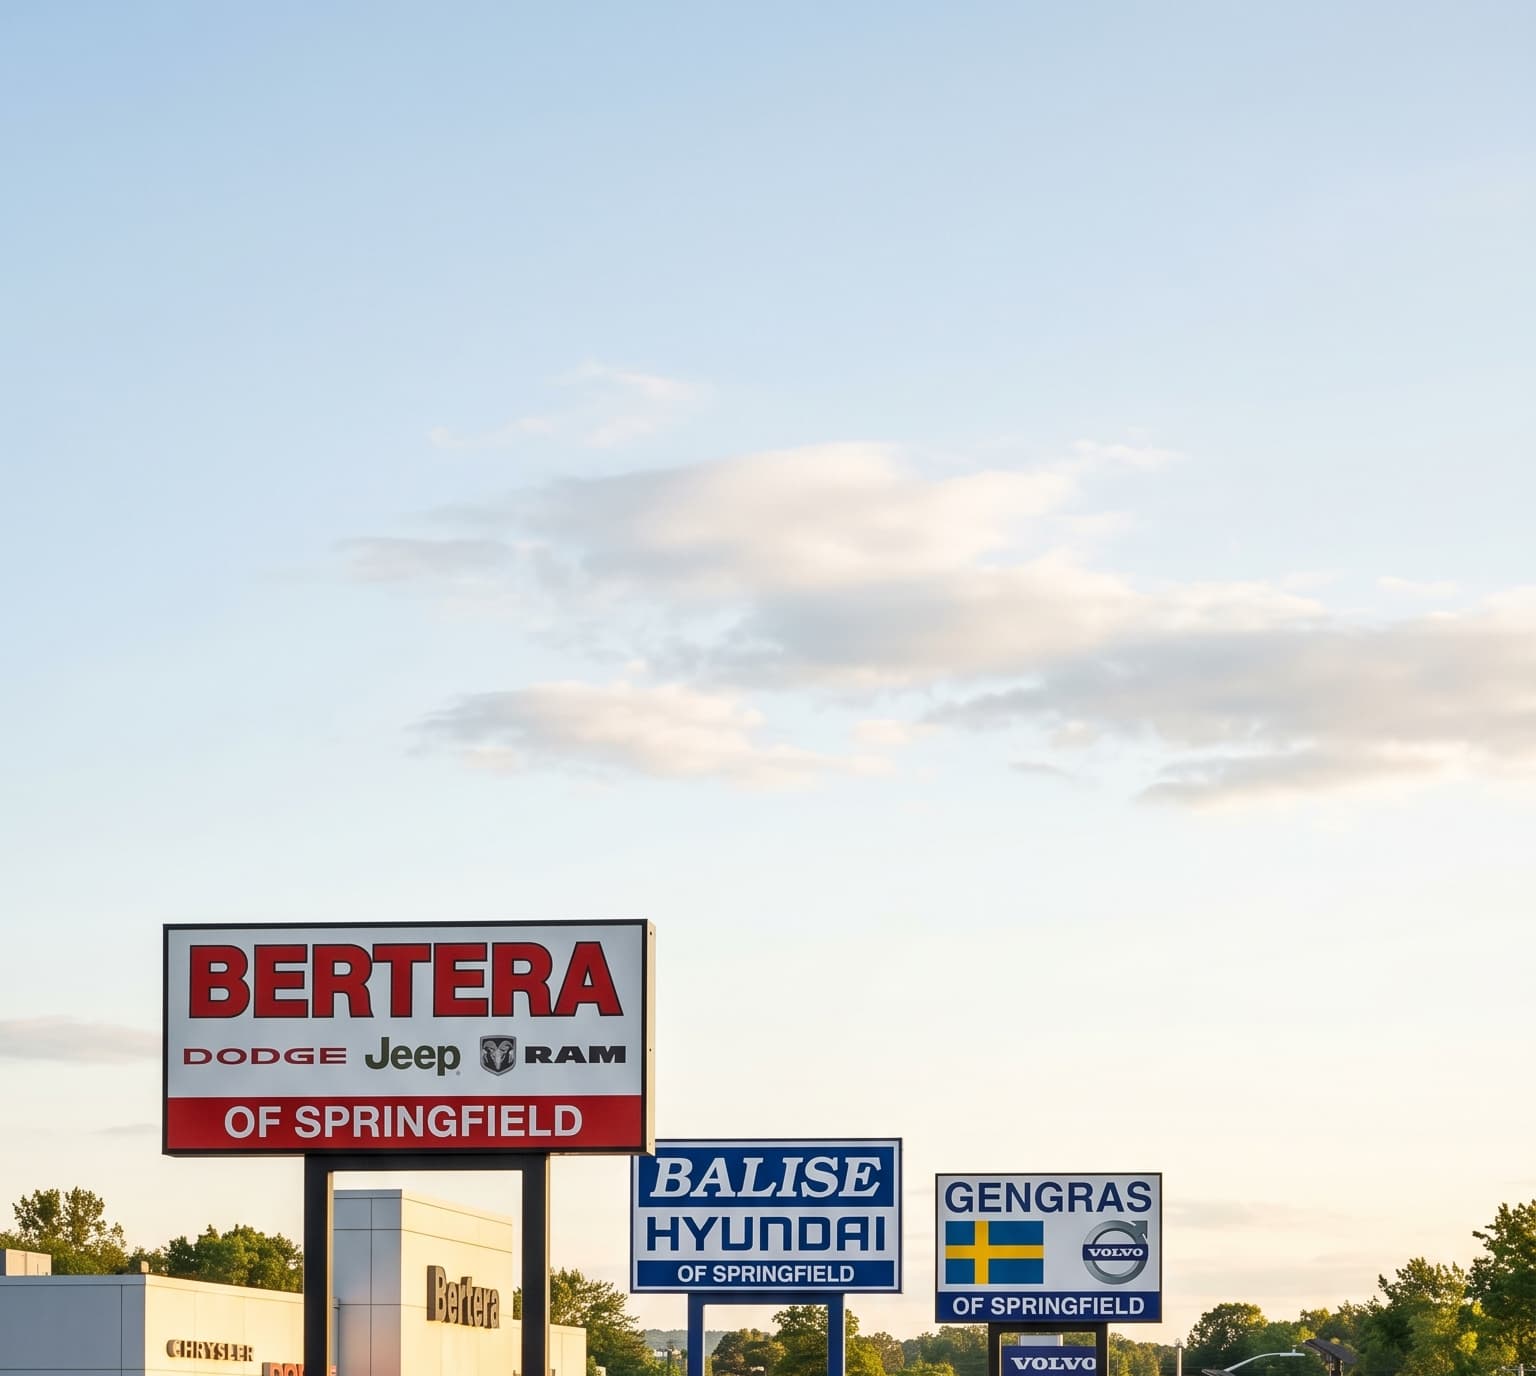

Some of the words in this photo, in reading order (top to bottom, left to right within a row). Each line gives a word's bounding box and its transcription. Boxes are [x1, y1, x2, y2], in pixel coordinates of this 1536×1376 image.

[189, 941, 624, 1019] BERTERA
[184, 1047, 347, 1065] DODGE
[365, 1037, 461, 1076] Jeep
[525, 1045, 627, 1064] RAM
[225, 1105, 281, 1139] OF
[294, 1104, 583, 1139] SPRINGFIELD
[650, 1156, 882, 1199] BALISE
[944, 1180, 1152, 1214] GENGRAS
[647, 1216, 885, 1252] HYUNDAI
[1088, 1248, 1144, 1257] VOLVO
[677, 1264, 707, 1283] OF
[712, 1264, 855, 1283] SPRINGFIELD
[426, 1264, 500, 1330] Bertera
[952, 1296, 985, 1316] OF
[990, 1296, 1145, 1316] SPRINGFIELD
[166, 1339, 254, 1362] CHRYSLER
[1011, 1357, 1096, 1370] VOLVO
